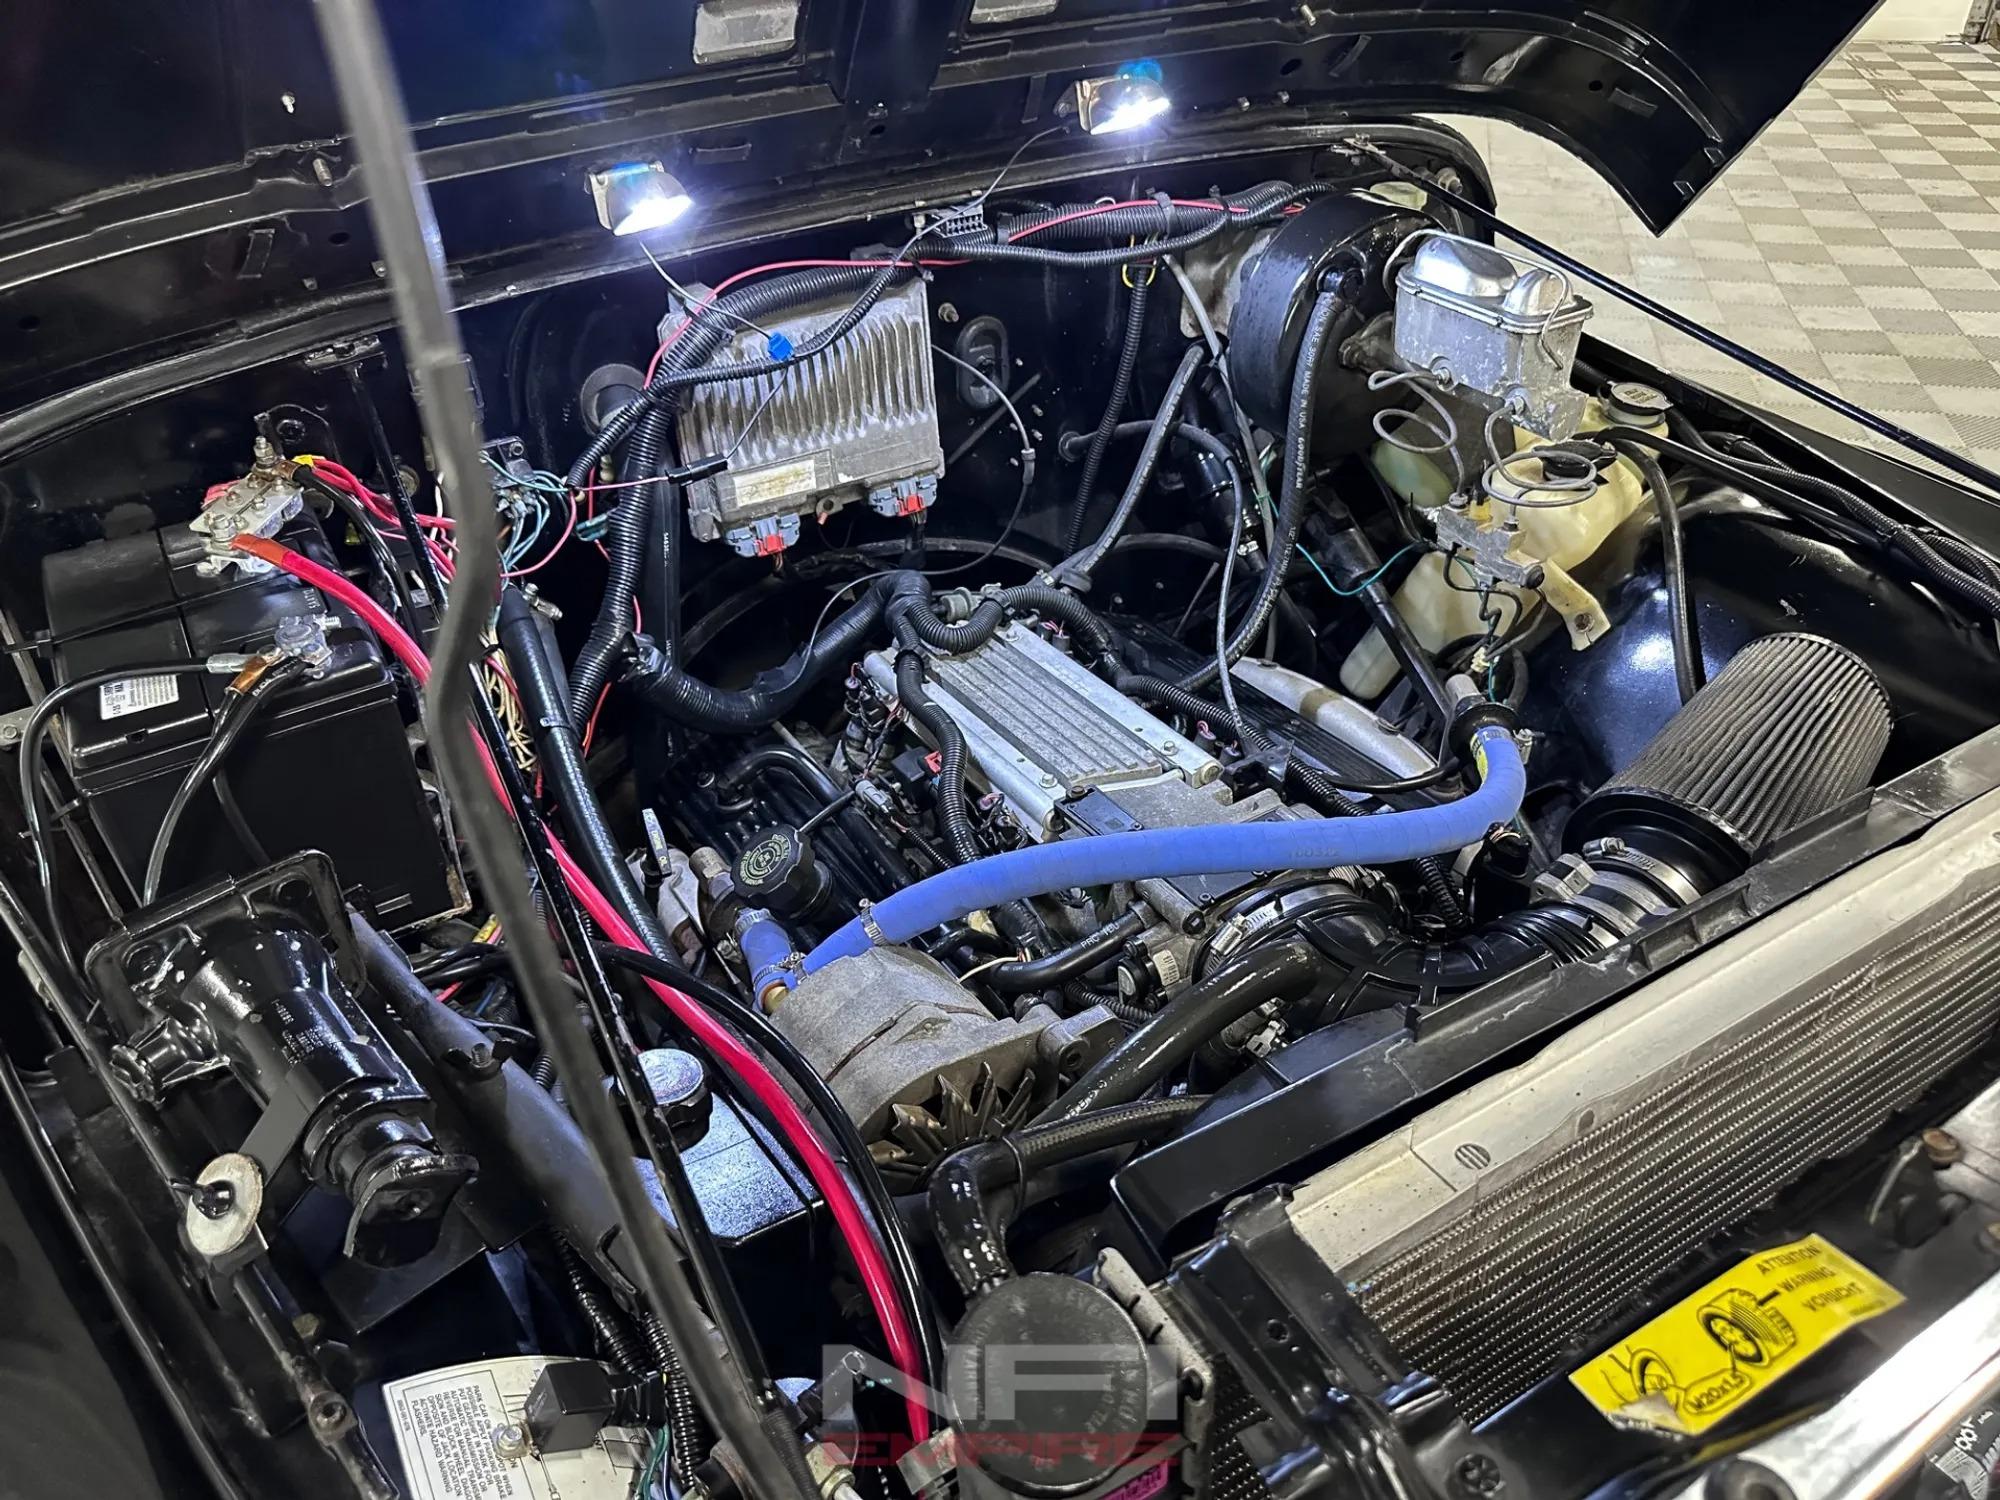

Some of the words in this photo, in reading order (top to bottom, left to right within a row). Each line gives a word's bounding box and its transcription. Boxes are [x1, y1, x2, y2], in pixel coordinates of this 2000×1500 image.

[1301, 369, 1312, 395] MADE
[1298, 411, 1308, 428] USA
[1295, 436, 1306, 490] GOODYEAR
[1755, 1243, 1822, 1276] ATTENTION
[1781, 1266, 1836, 1293] WARNING
[427, 1395, 442, 1428] OPPOSITE
[443, 1391, 457, 1421] REVERSE
[453, 1422, 462, 1437] FOR
[458, 1439, 472, 1467] MANUAL
[419, 1398, 434, 1428] ACTIVATE
[429, 1429, 443, 1458] HAZARD
[437, 1459, 453, 1492] WARNING
[435, 1393, 445, 1409] SION
[440, 1410, 450, 1425] AND
[445, 1426, 457, 1450] BLOCK
[453, 1452, 465, 1476] WHEEL
[437, 1429, 446, 1439] OF
[441, 1441, 451, 1459] JACK
[451, 1389, 467, 1426] AUTOMATIC
[463, 1428, 484, 1479] TRANSMISSION
[479, 1481, 488, 1492] OR
[458, 1388, 467, 1400] PUT
[463, 1402, 479, 1438] GEARSHIFT
[478, 1449, 488, 1468] PARK
[484, 1470, 493, 1485] FOR
[474, 1385, 483, 1402] PARK
[479, 1404, 488, 1417] CAR
[502, 1474, 513, 1495] WHEN
[447, 1461, 463, 1496] LOCATION
[476, 1419, 487, 1440] APPLY
[484, 1442, 498, 1473] PARKING
[494, 1474, 506, 1499] BRAKE
